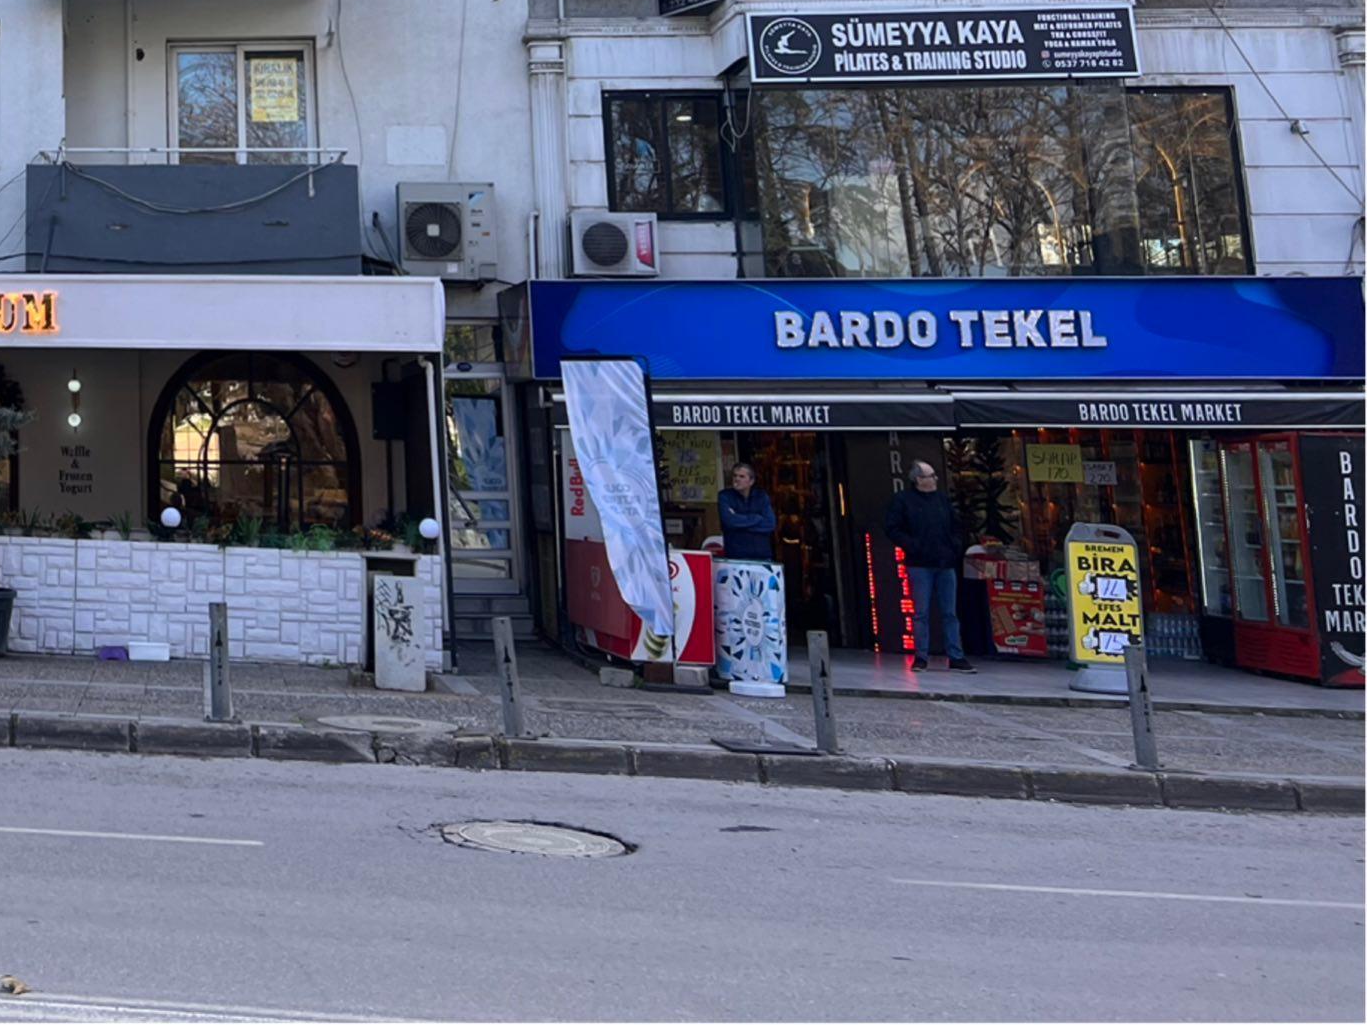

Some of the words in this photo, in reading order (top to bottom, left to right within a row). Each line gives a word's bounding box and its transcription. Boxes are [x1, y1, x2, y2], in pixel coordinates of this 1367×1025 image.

[831, 17, 951, 48] SÜMEYYA
[957, 19, 1025, 45] KAYA
[834, 50, 890, 72] PİLATES
[892, 54, 903, 71] &
[904, 50, 972, 71] TRAINING
[973, 49, 1027, 69] STUDIO
[774, 310, 937, 349] BARDO
[949, 309, 1108, 349] TEKEL
[673, 405, 721, 423] BARDO
[725, 405, 767, 423] TEKEL
[771, 405, 830, 424] MARKET
[1078, 403, 1129, 421] BARDO
[1132, 403, 1177, 421] TEKEL
[1181, 403, 1242, 422] MARKET
[59, 481, 92, 495] Yogurt
[1339, 451, 1362, 580] BARDO
[1085, 544, 1124, 553] BREMEN
[1077, 552, 1137, 573] BİRA
[1097, 604, 1122, 612] EFES
[1082, 612, 1140, 627] MALT
